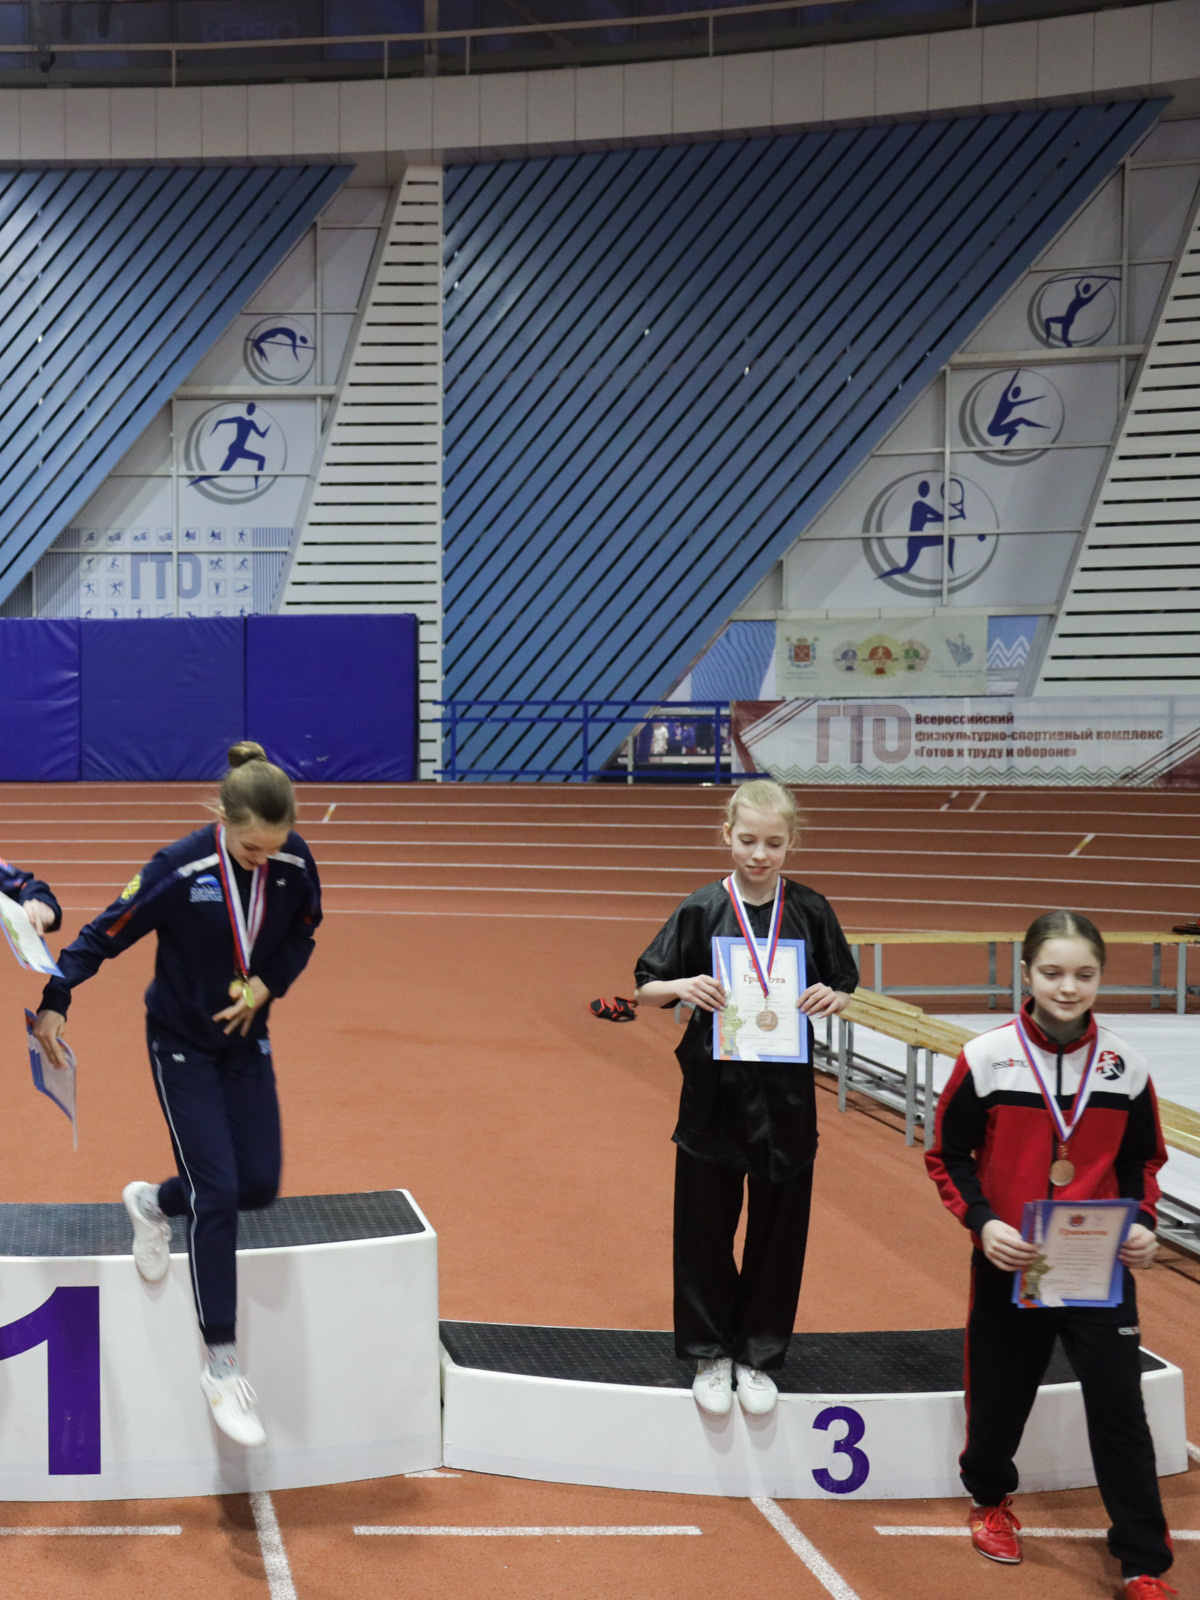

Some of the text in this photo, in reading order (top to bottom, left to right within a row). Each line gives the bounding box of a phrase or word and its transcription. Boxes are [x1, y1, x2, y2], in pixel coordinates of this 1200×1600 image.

[131, 552, 201, 599] ГТО
[915, 712, 1014, 725] Всероссийский
[817, 705, 911, 763] ГТО
[1096, 730, 1163, 741] комплекс
[915, 745, 1077, 759] «Готов к труду и обороне»
[743, 974, 786, 984] Граота
[811, 1406, 870, 1494] 3
